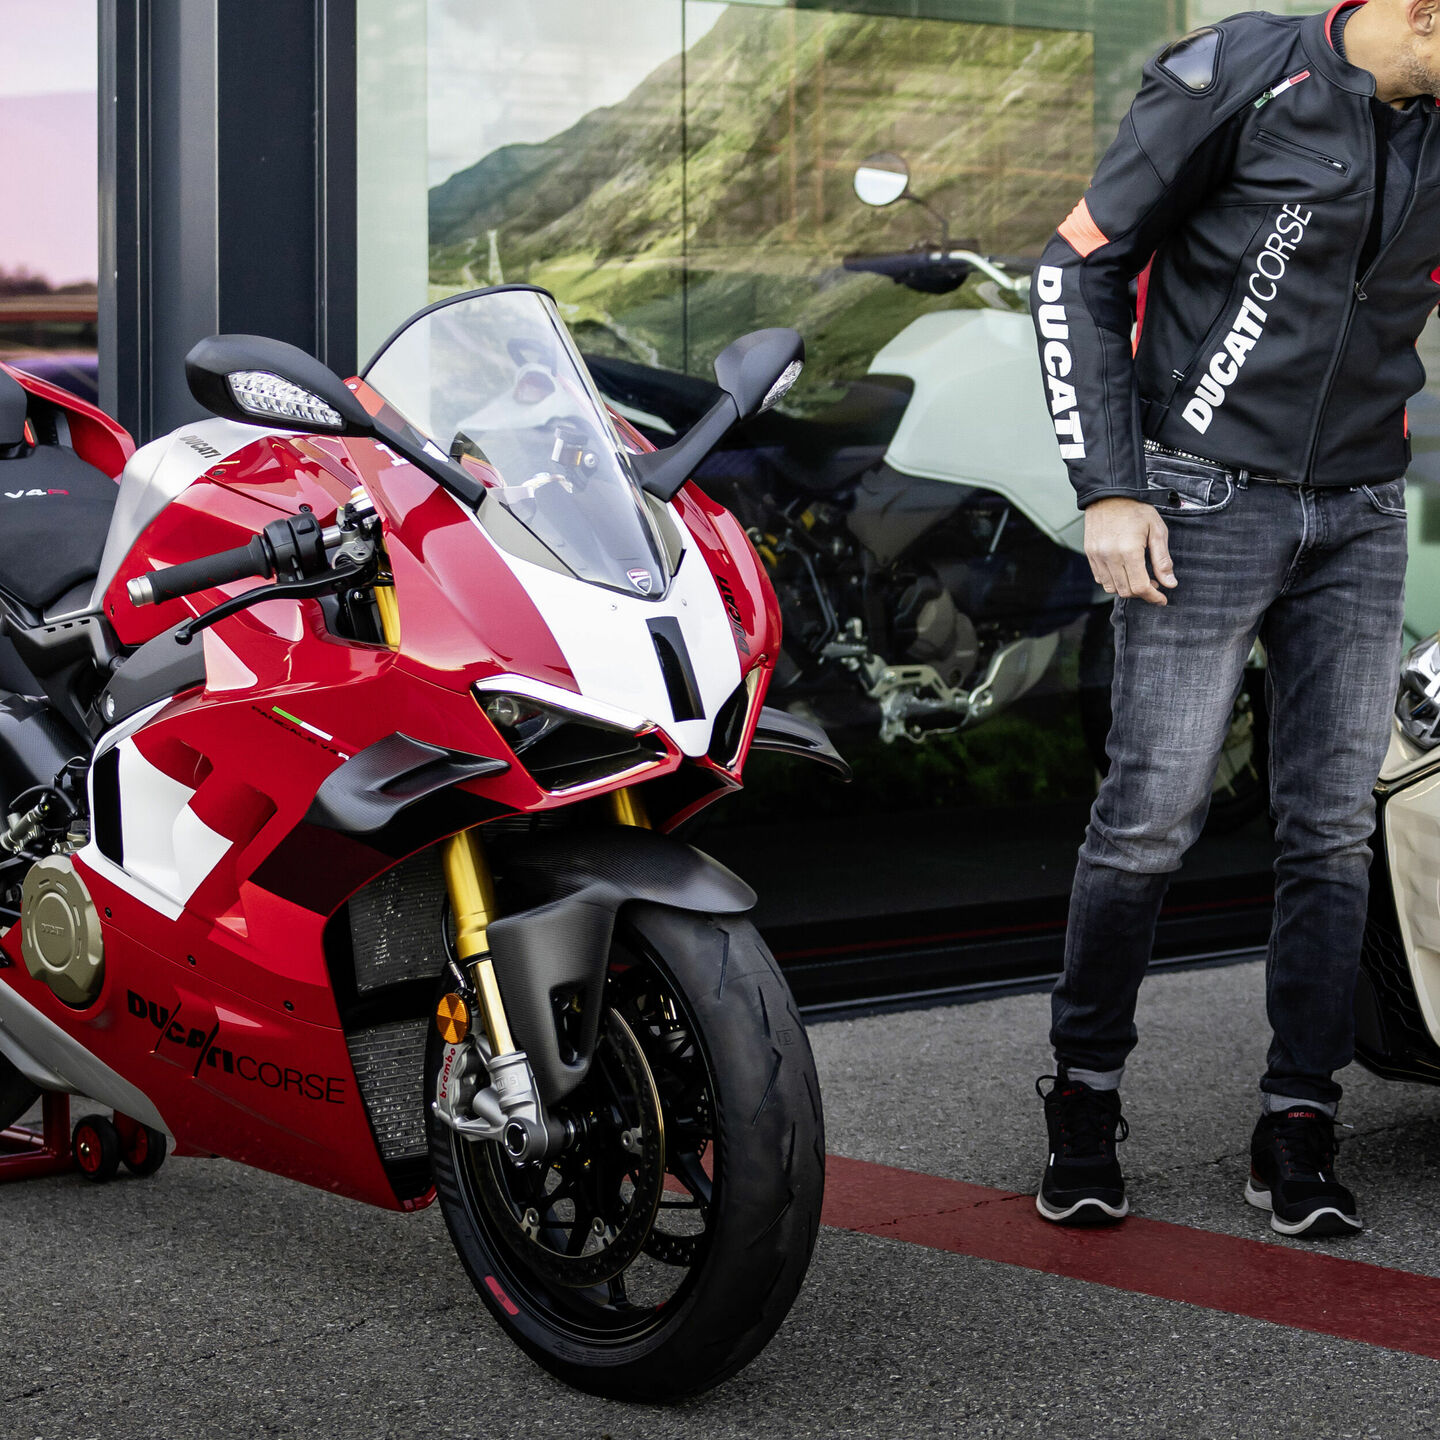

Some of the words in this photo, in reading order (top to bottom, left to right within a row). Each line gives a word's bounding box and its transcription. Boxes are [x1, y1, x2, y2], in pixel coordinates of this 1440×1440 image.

[1037, 265, 1087, 459] DUCATI
[1181, 295, 1268, 435] DUCATI
[1248, 203, 1313, 302] CORSE
[179, 434, 222, 459] DUCATI
[715, 574, 751, 657] DUCATI
[127, 989, 235, 1075] DUCATI
[235, 1055, 347, 1105] CORSE
[439, 1047, 457, 1099] brembo
